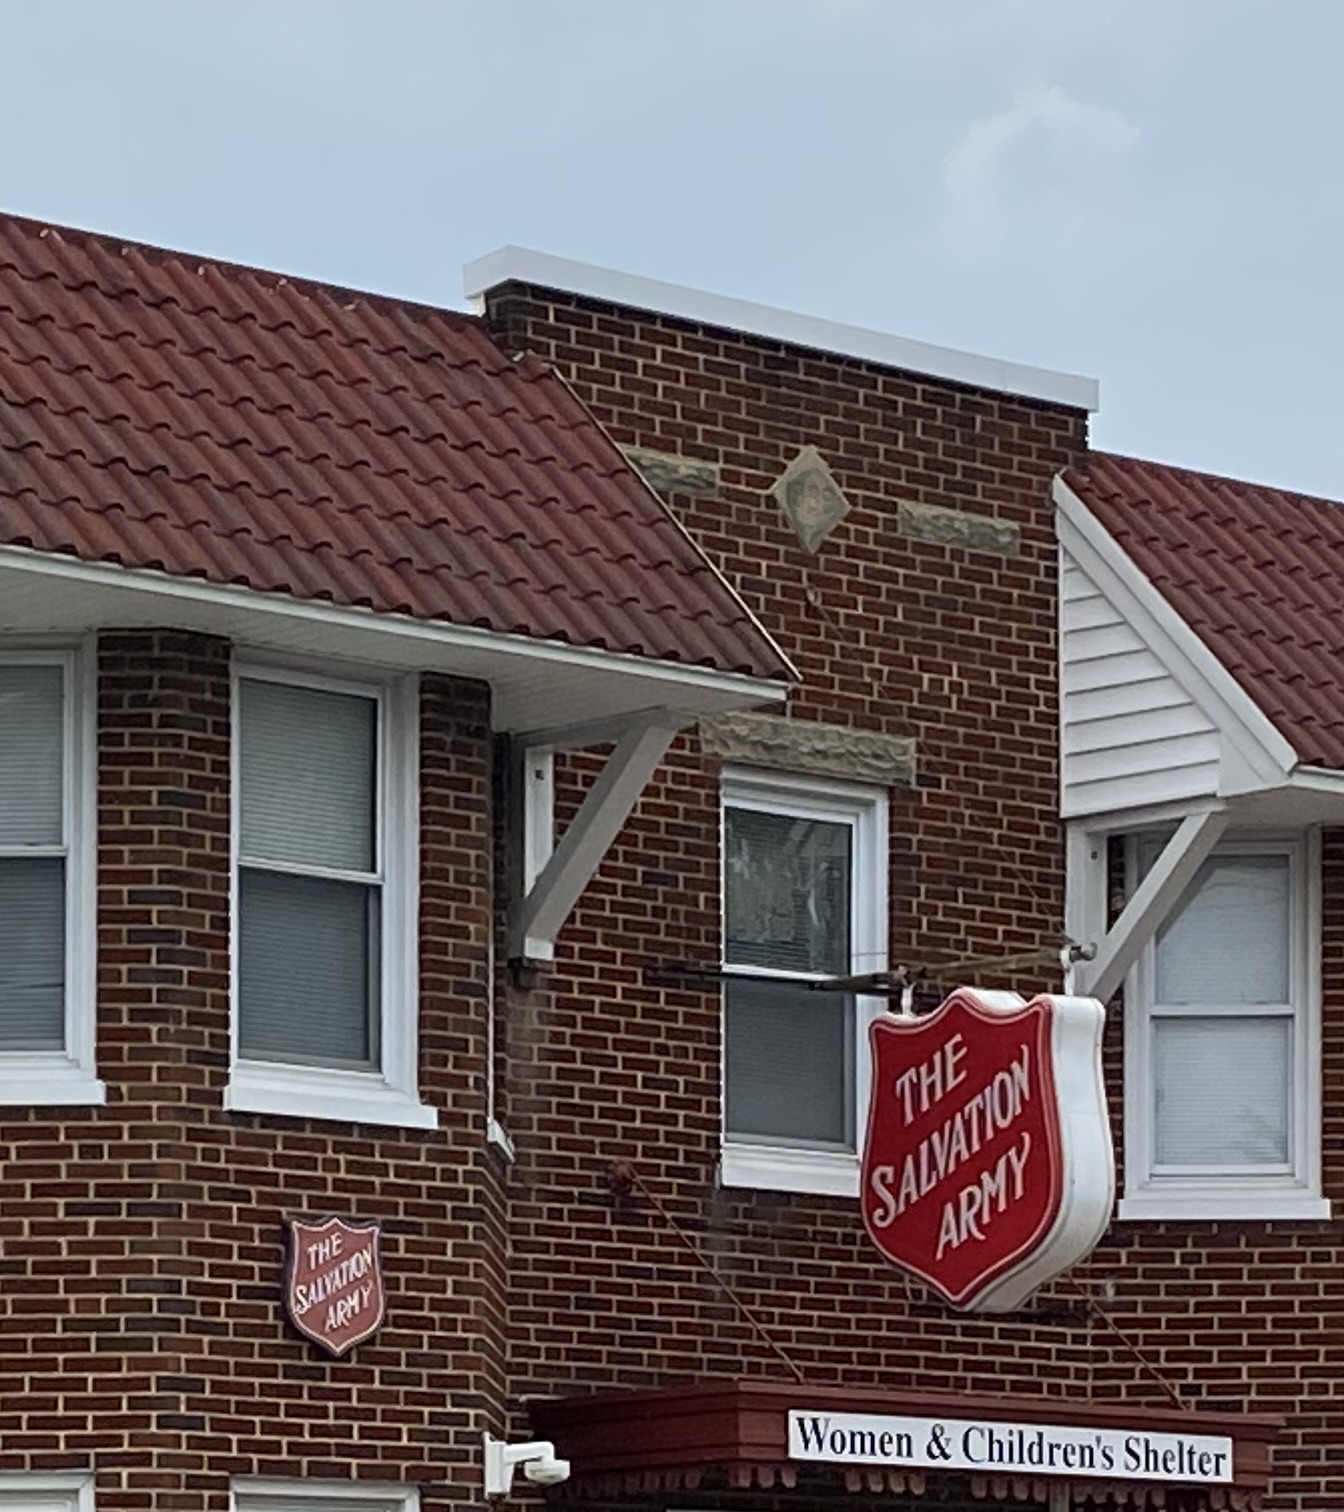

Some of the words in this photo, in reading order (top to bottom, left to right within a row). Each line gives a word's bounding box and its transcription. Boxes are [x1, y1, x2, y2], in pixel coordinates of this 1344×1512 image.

[896, 1033, 968, 1127] THE
[871, 1044, 1031, 1228] SALVATION
[936, 1133, 1031, 1261] ARMY
[296, 1243, 373, 1314] SALVATION
[307, 1231, 344, 1270] THE
[324, 1279, 374, 1333] ARMY
[795, 1416, 914, 1458] Women
[926, 1423, 952, 1461] &
[962, 1426, 1114, 1470] Children's
[1124, 1436, 1227, 1476] Shelter
